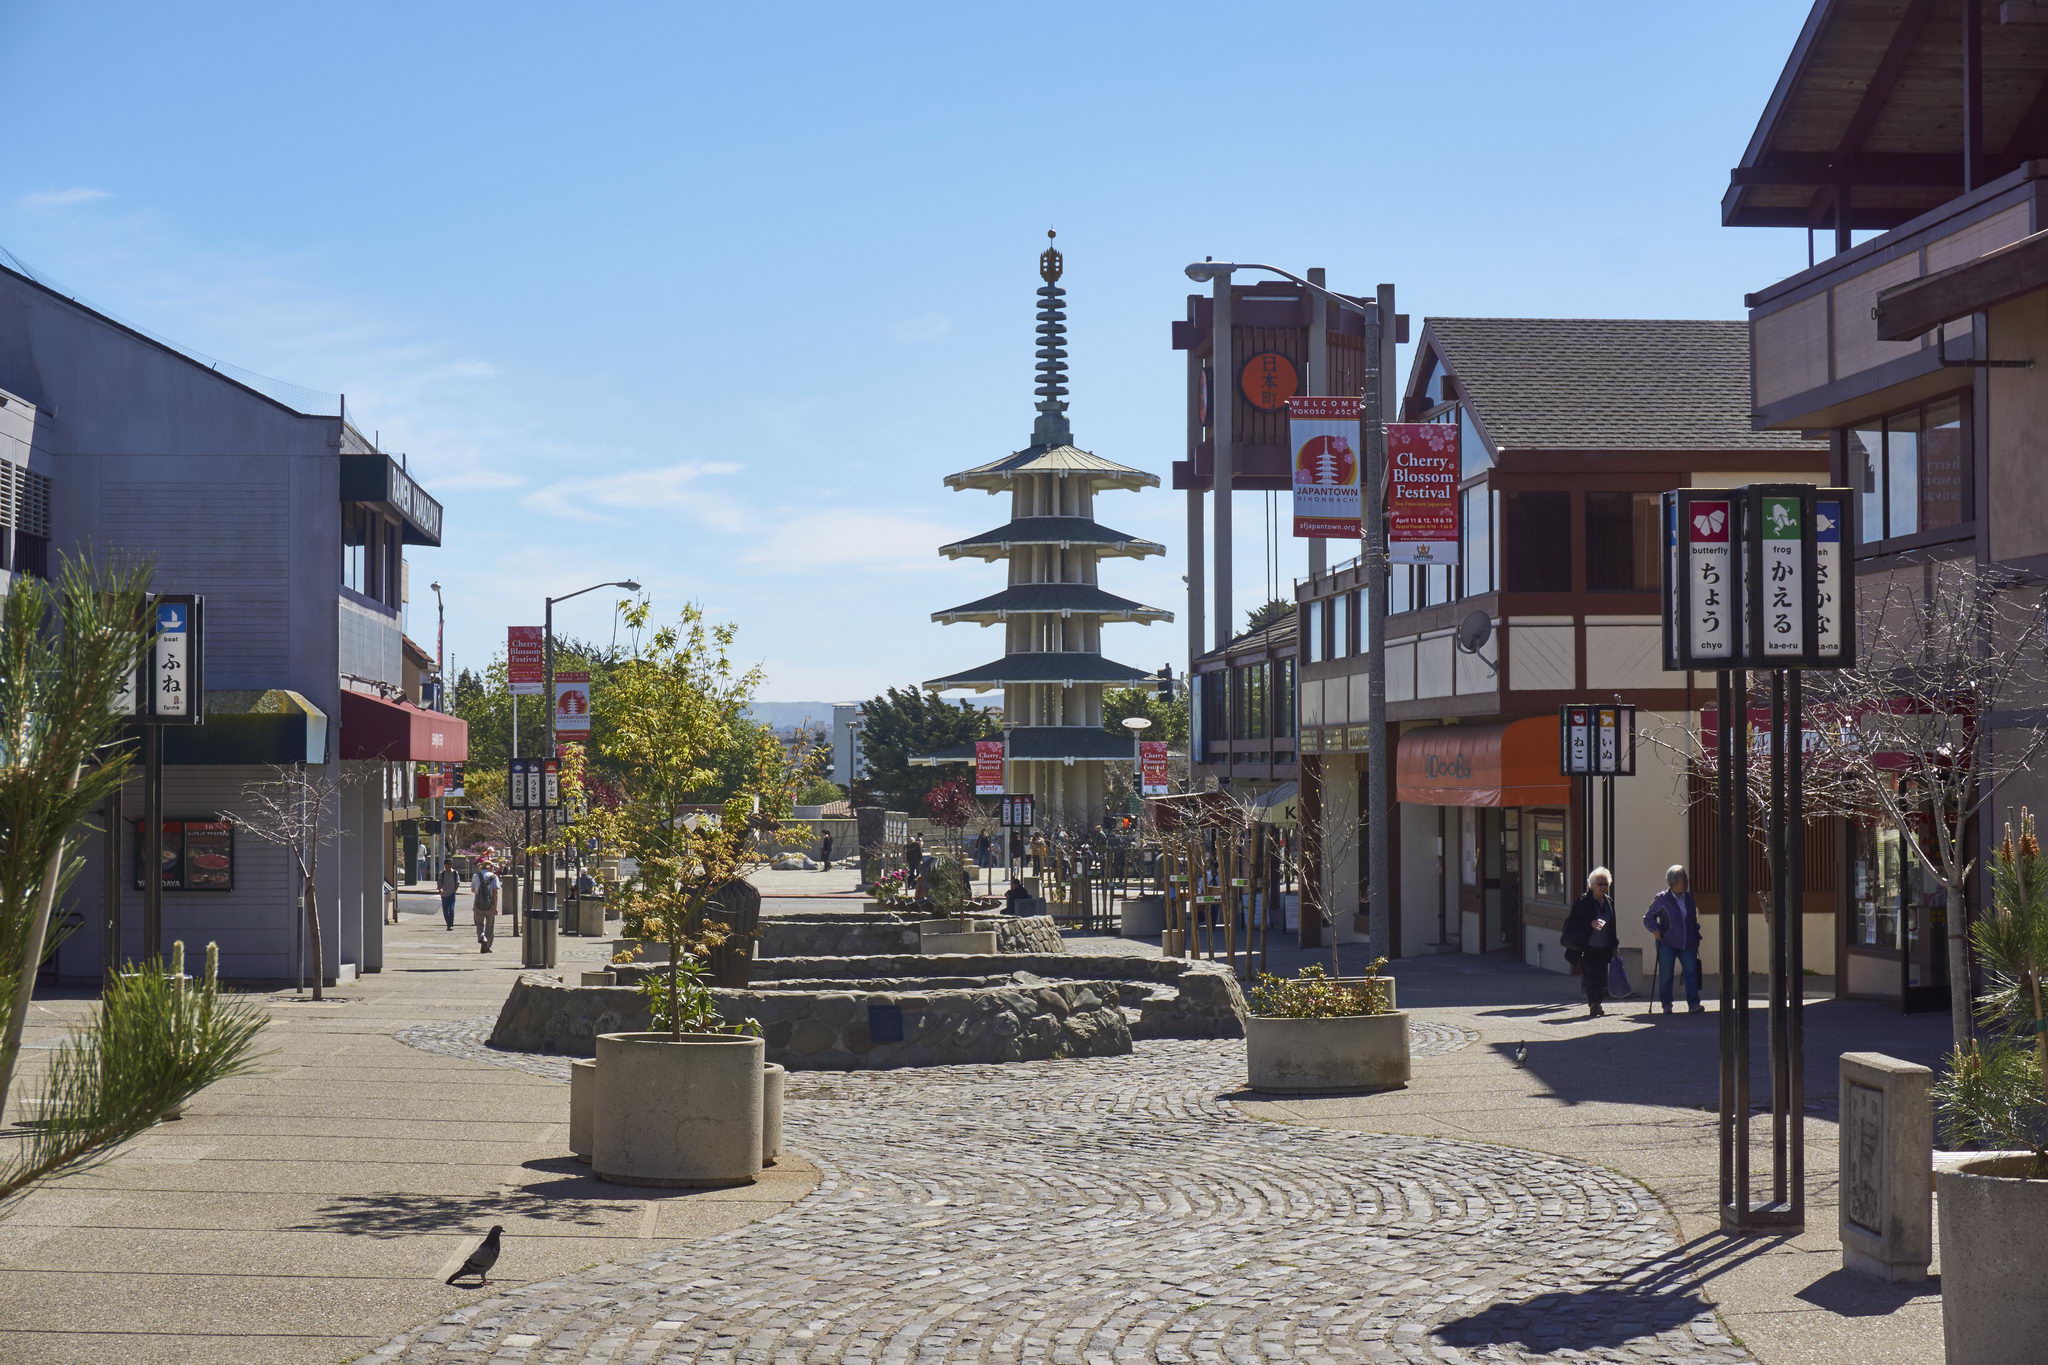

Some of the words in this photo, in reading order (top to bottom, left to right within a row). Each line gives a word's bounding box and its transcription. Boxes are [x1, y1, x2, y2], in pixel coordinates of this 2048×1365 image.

[1262, 356, 1279, 409] 日本町
[1396, 453, 1448, 471] Cherry
[1393, 468, 1454, 483] Blossom
[1296, 487, 1358, 496] JAPANTOWN
[1396, 484, 1451, 499] Festival
[1300, 522, 1356, 532] sfjapantown.org
[1692, 546, 1728, 556] butterfly
[1773, 546, 1792, 555] frog
[1701, 563, 1720, 633] ちょう
[1771, 560, 1793, 634] かえる
[510, 647, 541, 655] Blossom
[511, 640, 539, 649] Cherry
[1701, 642, 1723, 651] chyo
[511, 655, 540, 663] Festival
[161, 653, 181, 693] ふね
[1574, 736, 1585, 760] ねこ
[1601, 737, 1612, 760] いぬ
